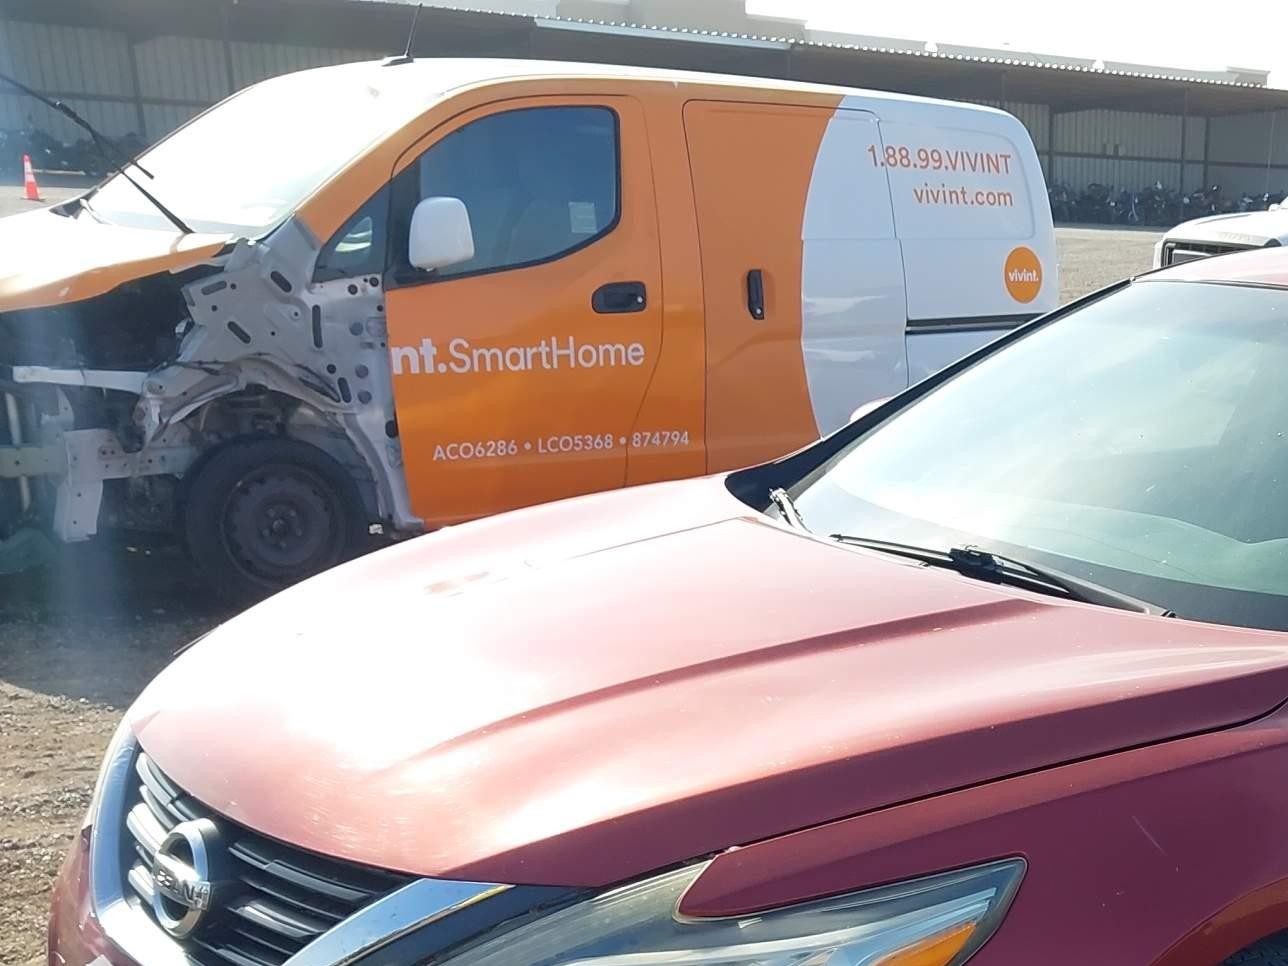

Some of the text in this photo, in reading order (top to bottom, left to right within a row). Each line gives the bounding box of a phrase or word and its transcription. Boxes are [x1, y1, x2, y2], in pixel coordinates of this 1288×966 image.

[868, 144, 1011, 174] 1.88.99.VIVINT
[913, 182, 1014, 207] vivint.com
[631, 430, 689, 448] 874794
